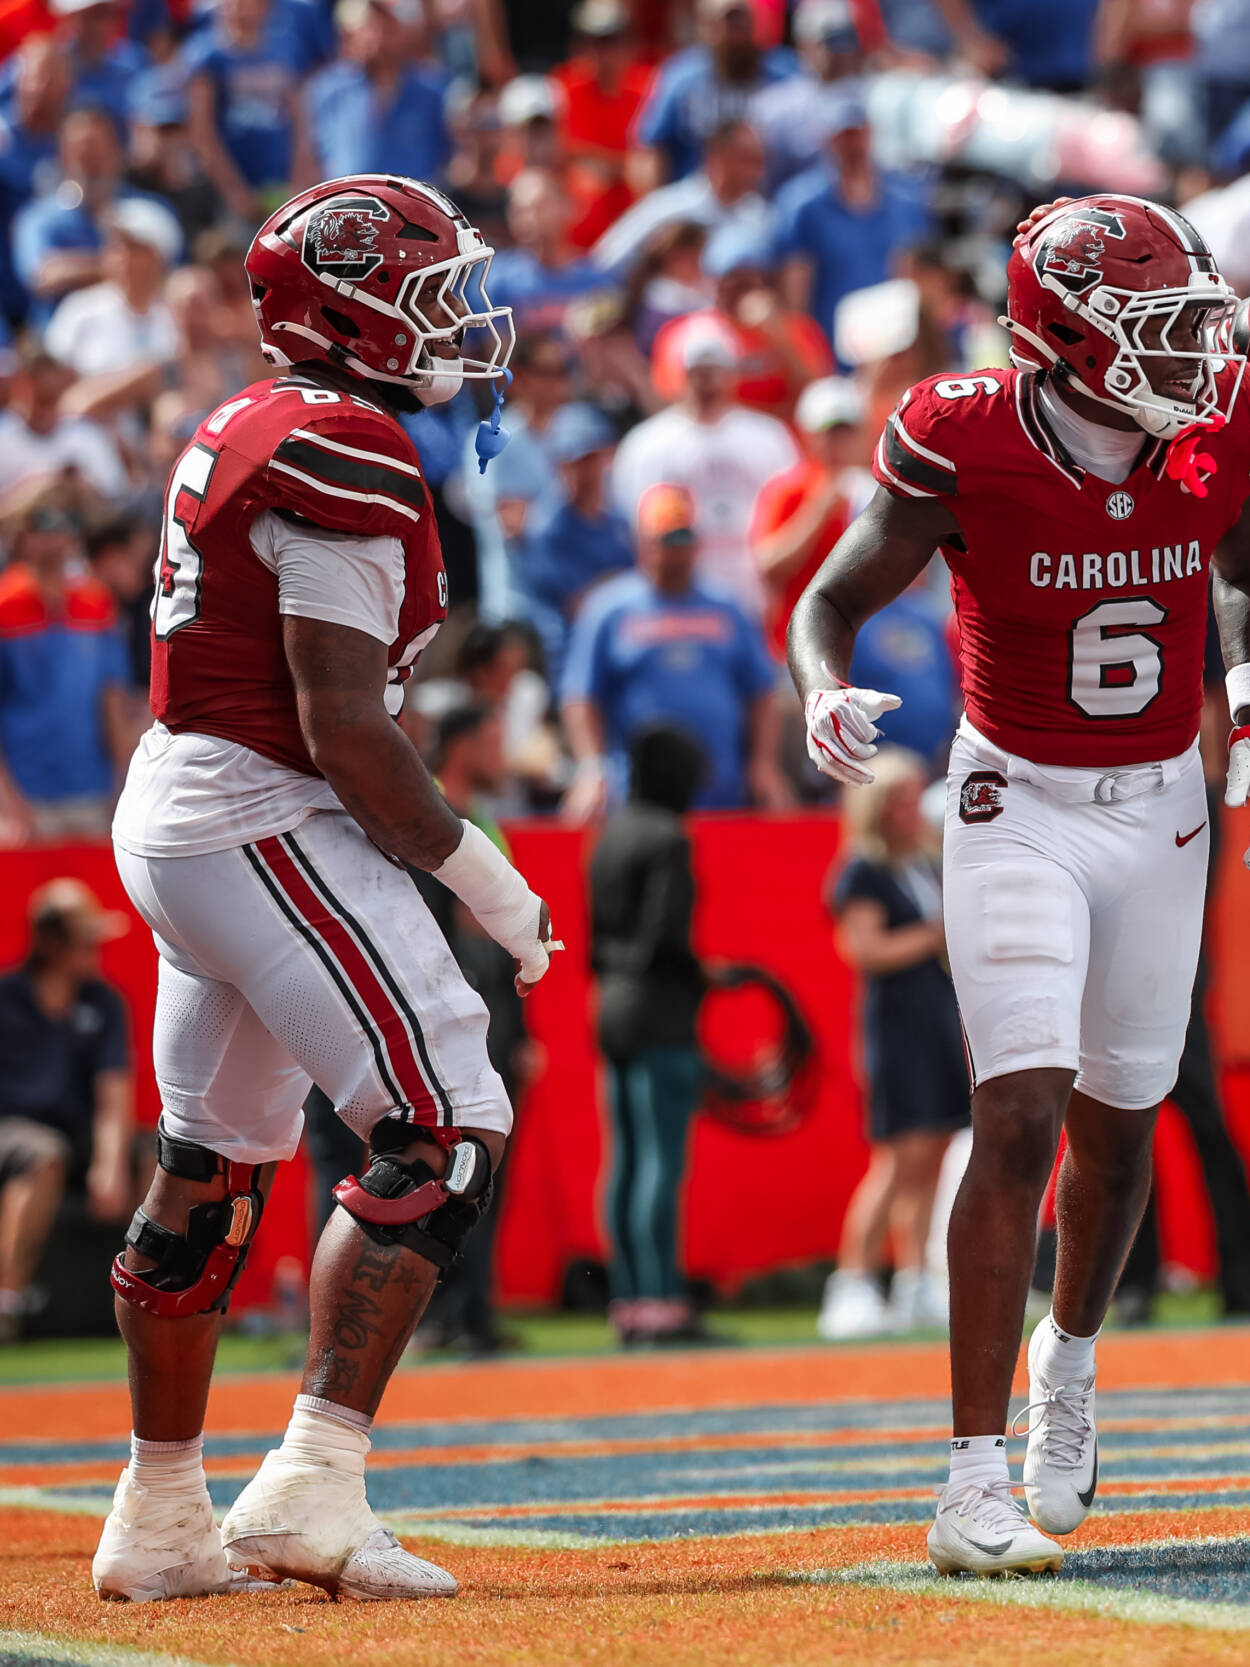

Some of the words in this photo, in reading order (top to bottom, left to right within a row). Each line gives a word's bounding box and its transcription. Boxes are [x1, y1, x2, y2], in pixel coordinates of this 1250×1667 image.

[934, 376, 1001, 400] 6
[1106, 491, 1134, 520] SEC
[1029, 539, 1202, 590] CAROLINA
[1068, 596, 1169, 720] 6
